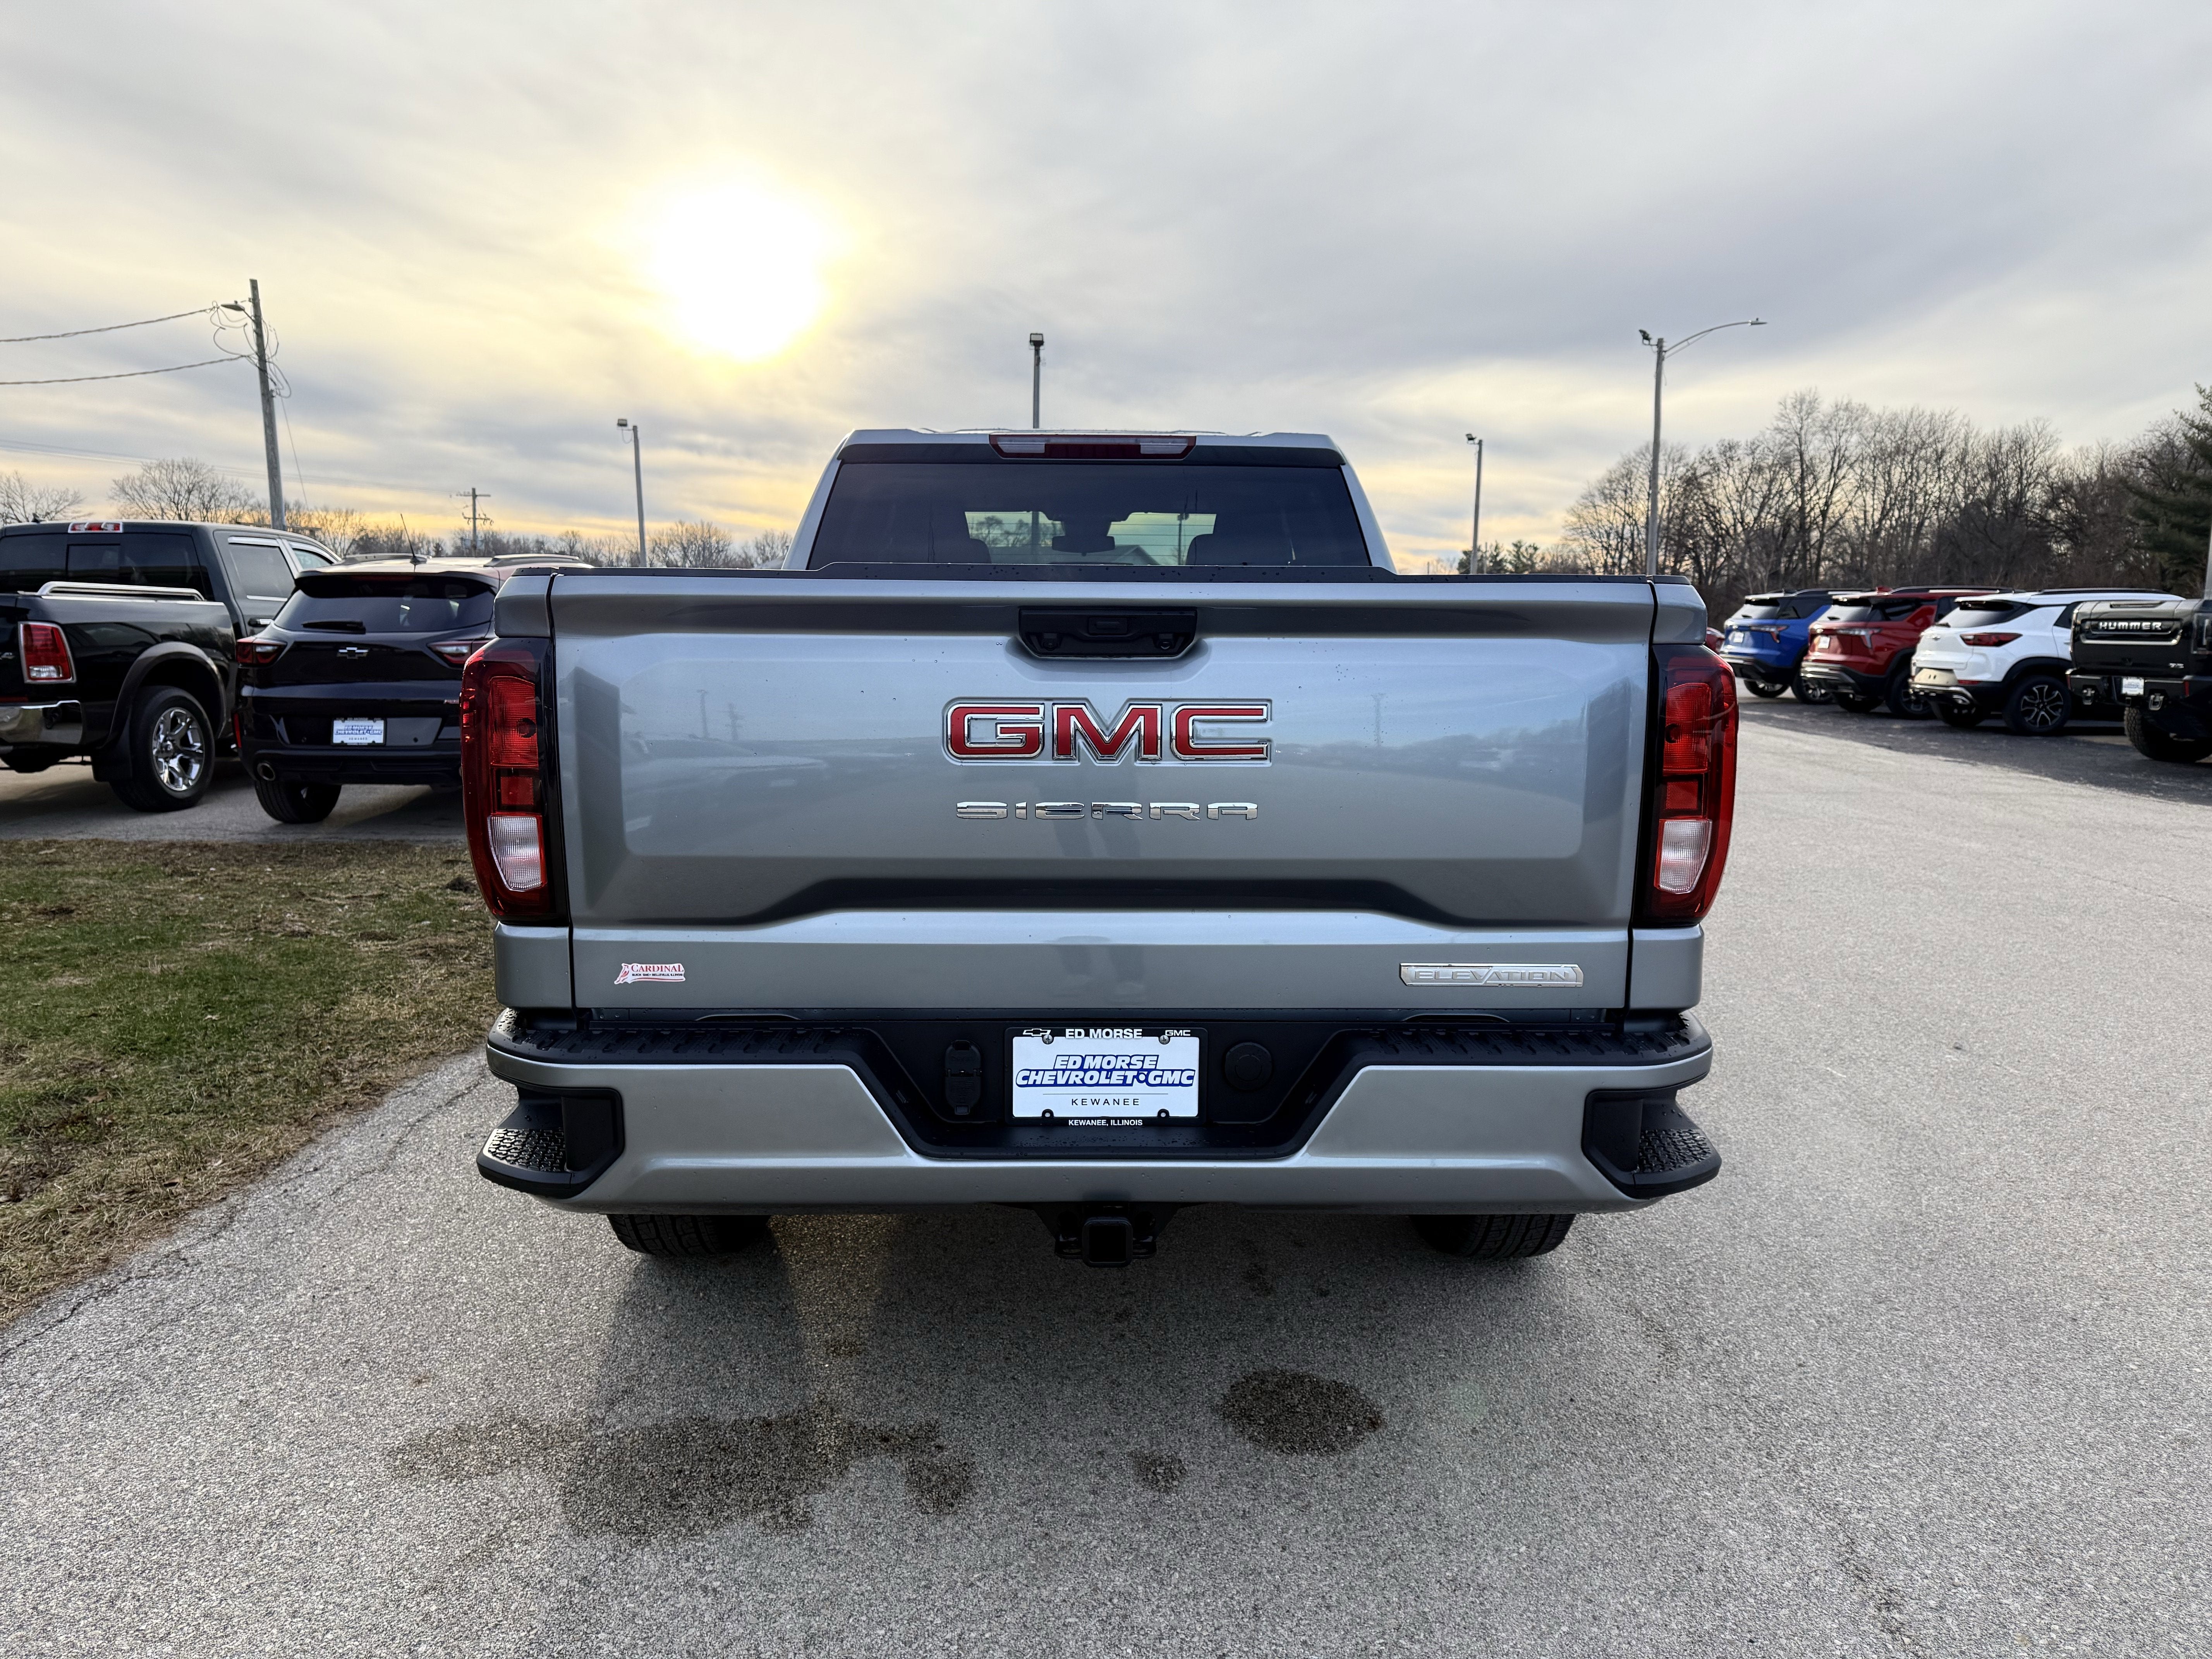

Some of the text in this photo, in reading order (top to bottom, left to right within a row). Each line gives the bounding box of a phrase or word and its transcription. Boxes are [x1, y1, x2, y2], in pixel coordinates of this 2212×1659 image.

[2099, 622, 2162, 630] HUMMER
[946, 702, 1268, 761] GMC
[956, 801, 1258, 820] SIERRA
[1414, 969, 1570, 981] ELEVATION
[1065, 1028, 1142, 1039] ED MORSE
[1054, 1056, 1158, 1069] ED MORSE
